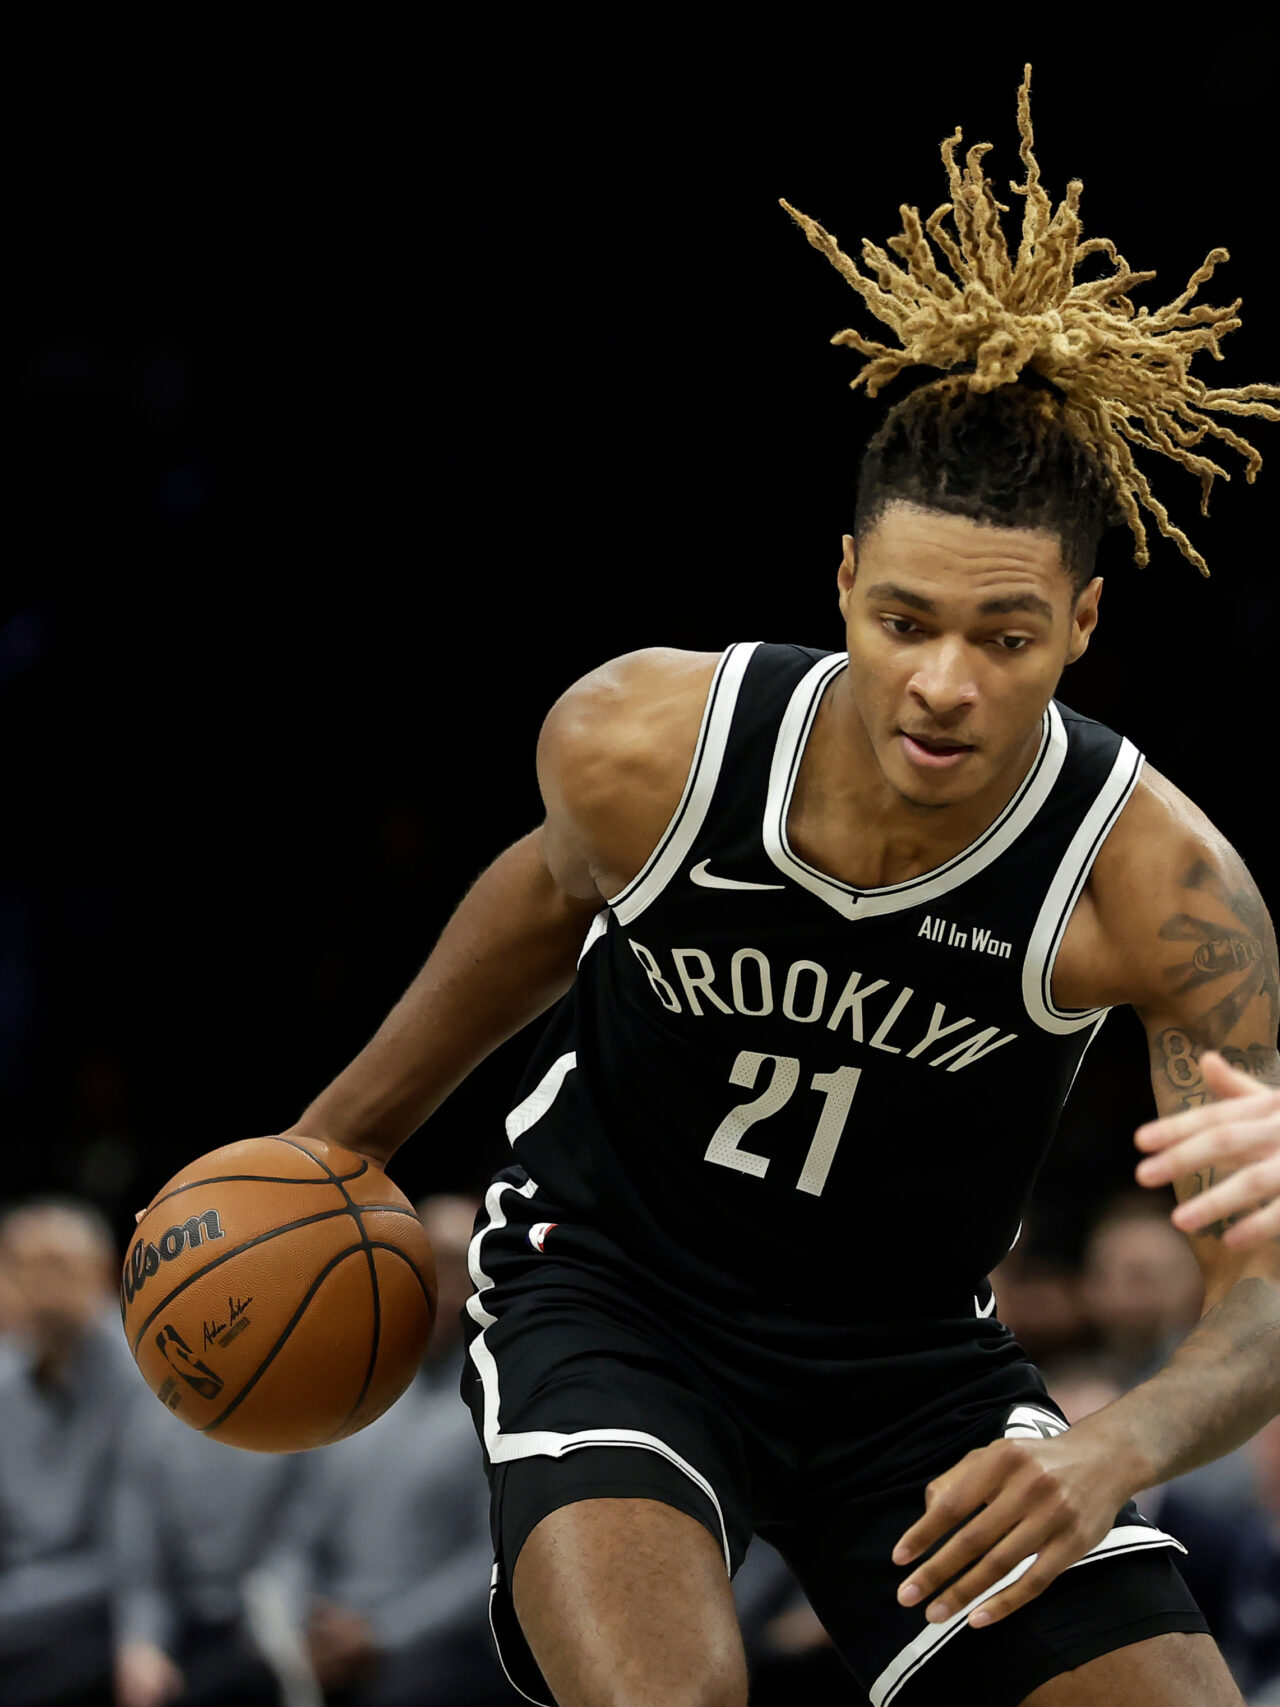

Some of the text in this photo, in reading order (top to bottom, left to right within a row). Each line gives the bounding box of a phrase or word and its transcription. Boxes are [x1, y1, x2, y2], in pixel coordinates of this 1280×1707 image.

[917, 915, 1013, 959] All In Won
[628, 938, 1019, 1073] BROOKLYN
[703, 1050, 863, 1197] 21
